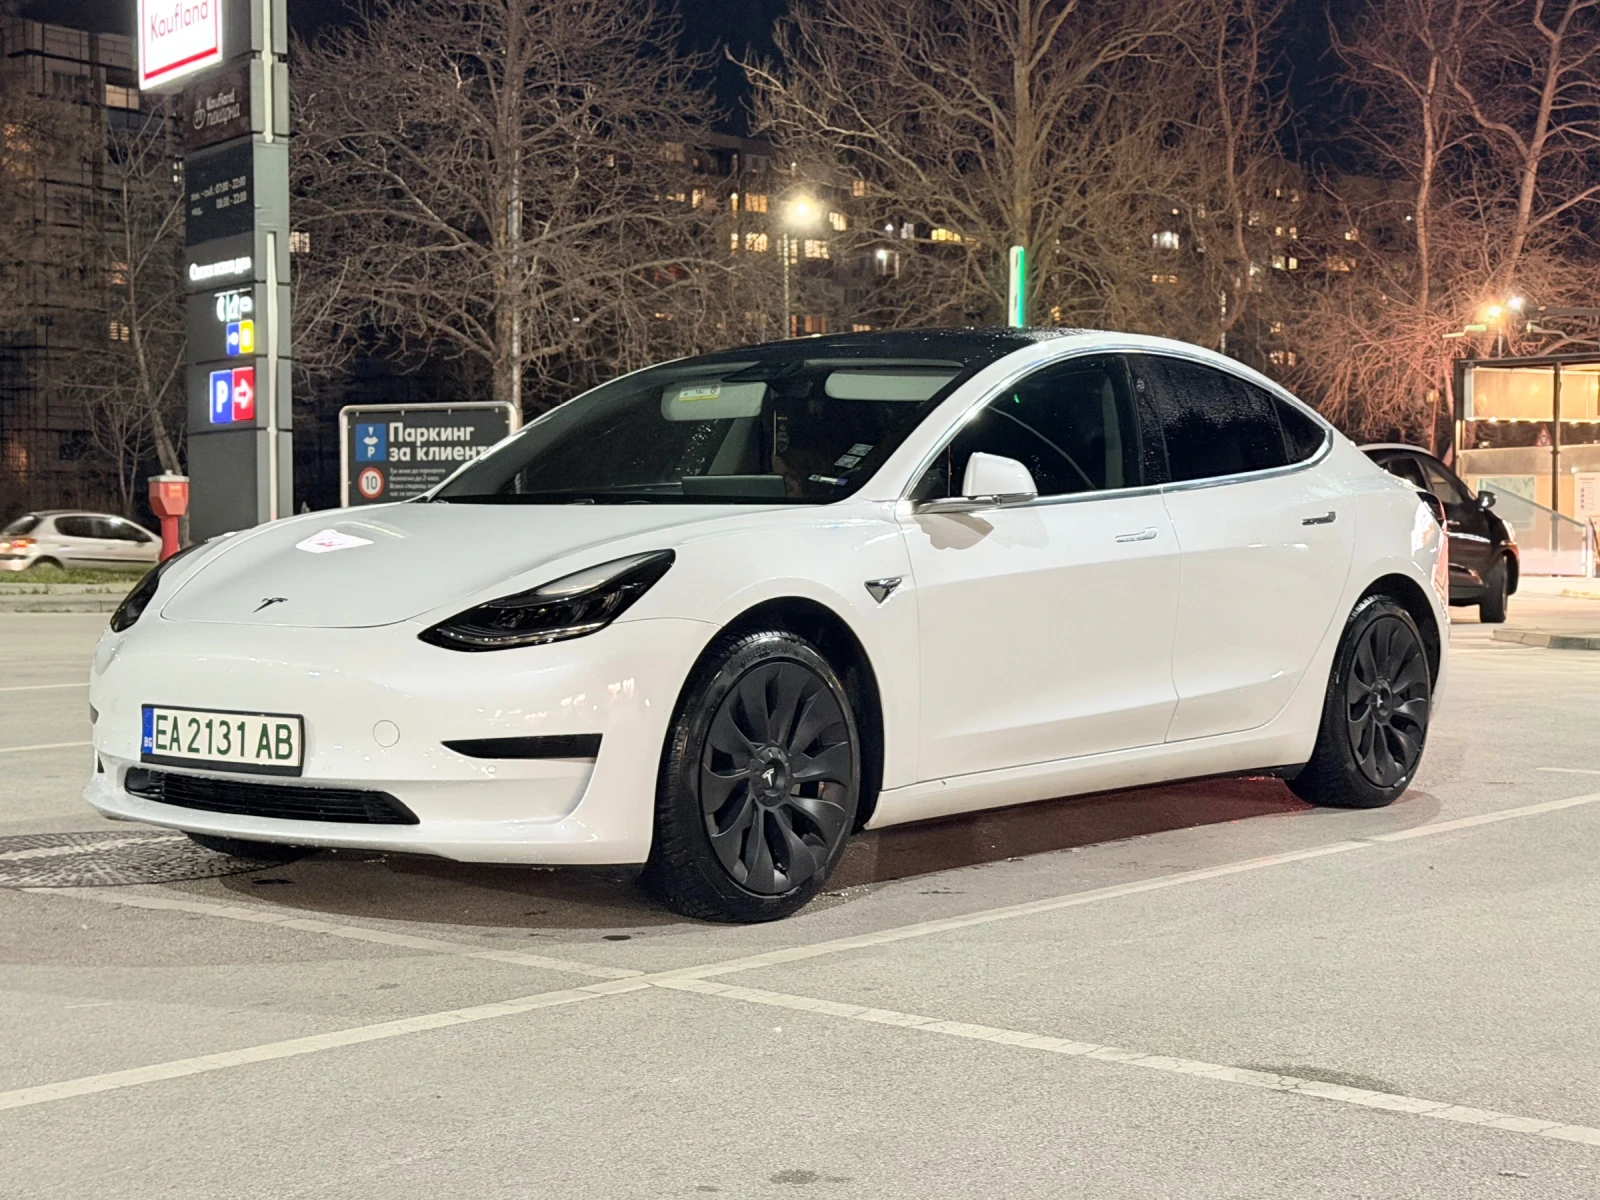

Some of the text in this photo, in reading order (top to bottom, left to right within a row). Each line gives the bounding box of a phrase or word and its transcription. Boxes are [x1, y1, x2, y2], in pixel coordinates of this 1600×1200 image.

[150, 0, 208, 42] Kaufland
[216, 380, 229, 413] P
[389, 422, 474, 446] Паркинг
[367, 446, 375, 458] P
[389, 446, 492, 461] за клиент
[365, 476, 378, 490] 10
[155, 714, 293, 760] EA 2131 AB
